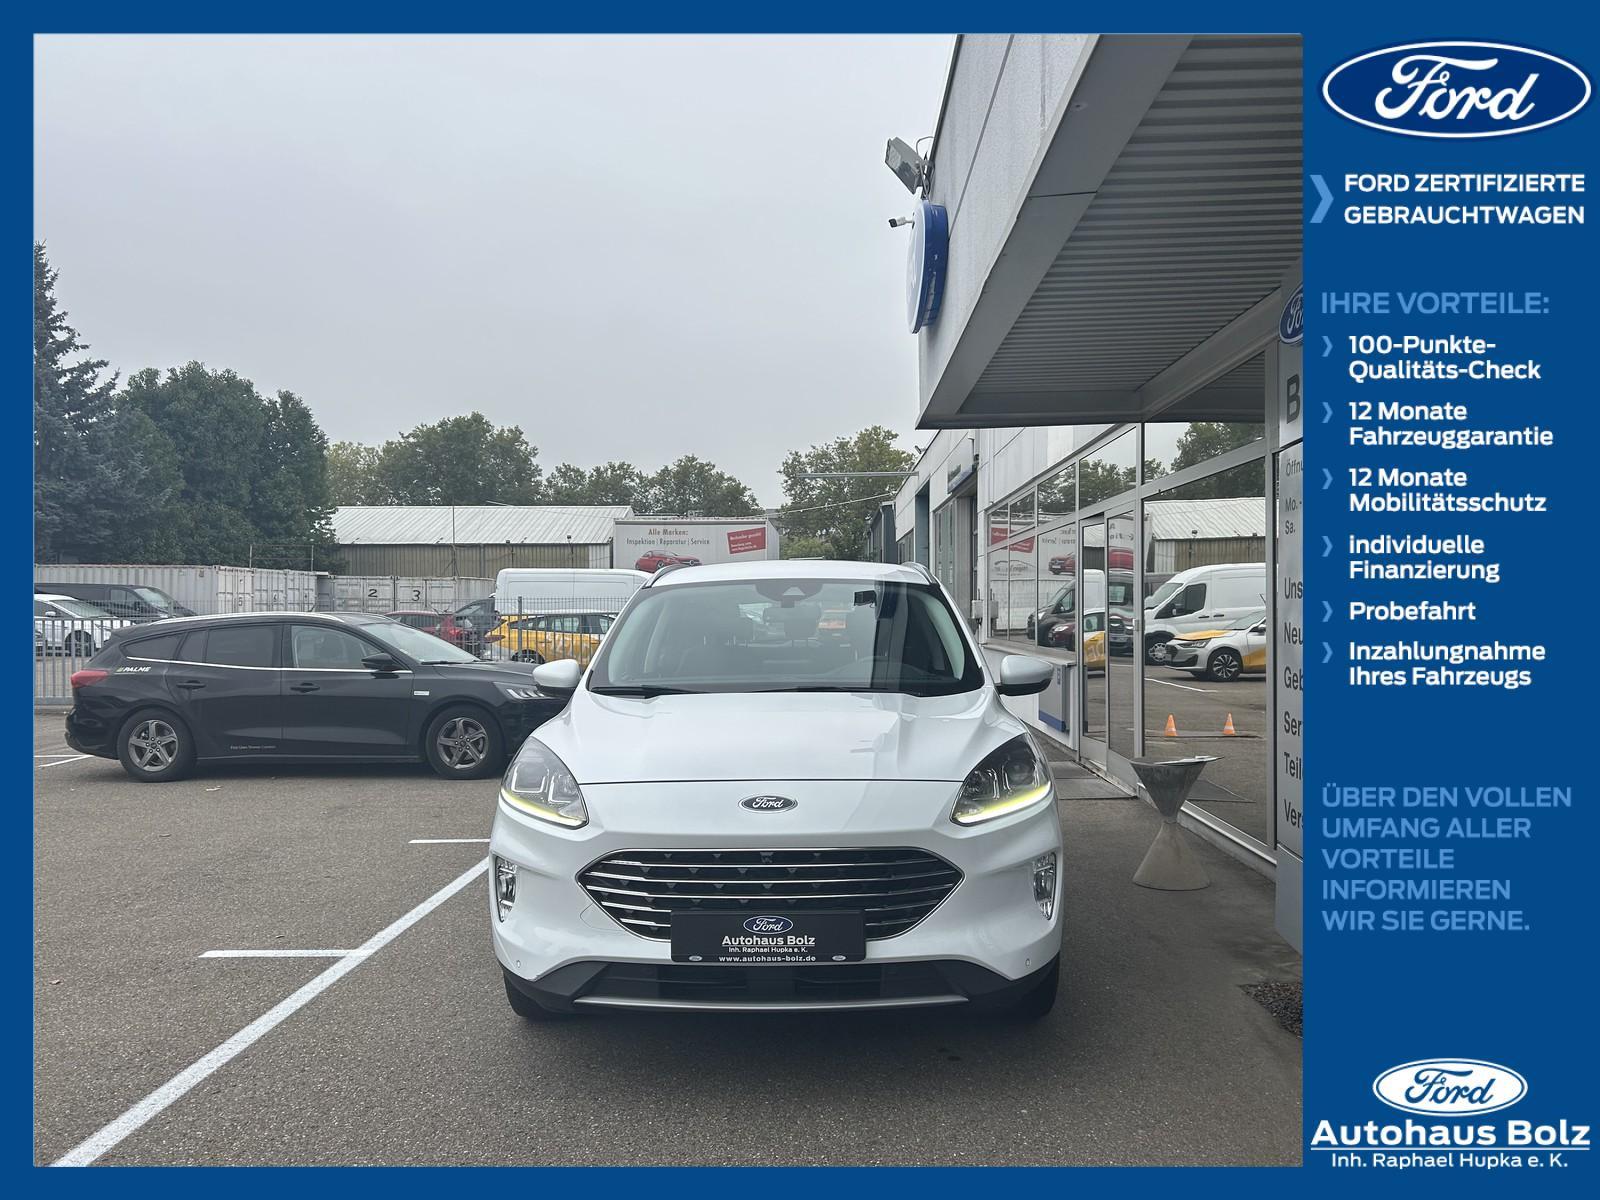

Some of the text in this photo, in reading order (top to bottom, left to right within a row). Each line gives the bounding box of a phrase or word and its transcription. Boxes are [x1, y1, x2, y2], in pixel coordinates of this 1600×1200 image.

[648, 528, 660, 536] Alle
[1285, 520, 1296, 535] Sa.
[660, 538, 686, 546] Reparatur
[368, 589, 378, 598] 2
[412, 590, 421, 601] 3
[752, 796, 784, 808] Ford
[1284, 798, 1303, 828] Ver
[753, 918, 783, 931] Ford
[722, 935, 815, 945] Autohaus Bolz
[742, 946, 770, 954] Raphael
[771, 946, 793, 954] Hupka
